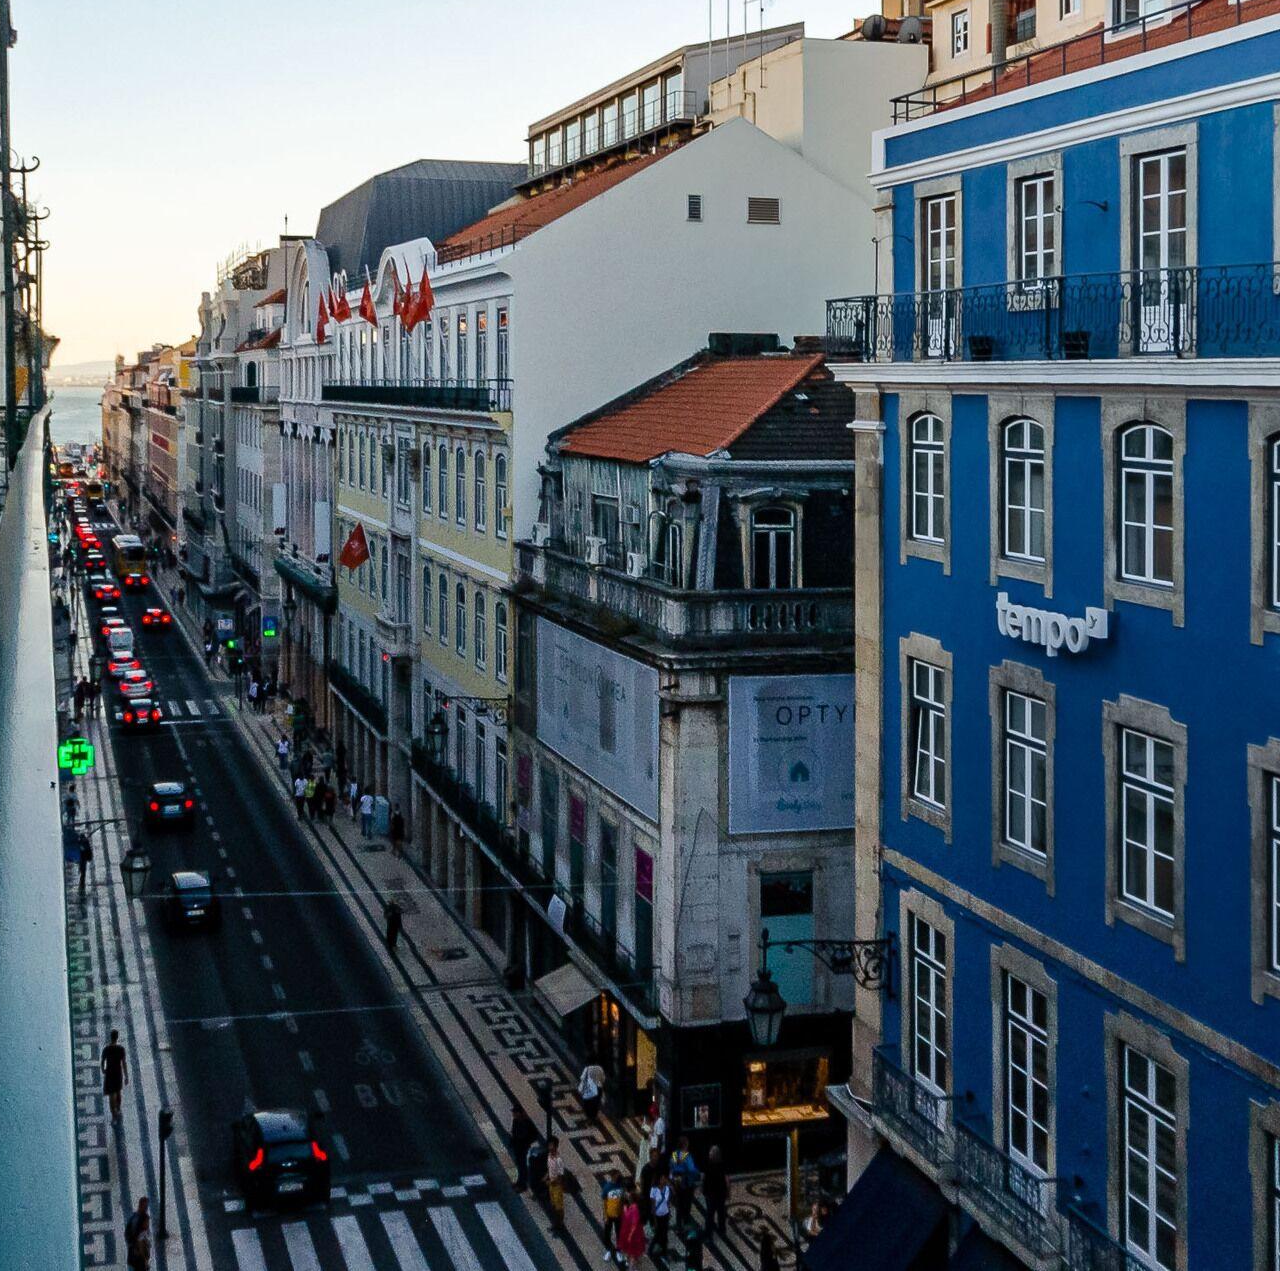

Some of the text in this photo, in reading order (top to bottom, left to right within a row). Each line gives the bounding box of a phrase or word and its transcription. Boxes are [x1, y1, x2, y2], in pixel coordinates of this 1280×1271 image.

[996, 592, 1089, 657] tempo
[776, 703, 856, 726] OPTY
[353, 1080, 428, 1108] BUS
